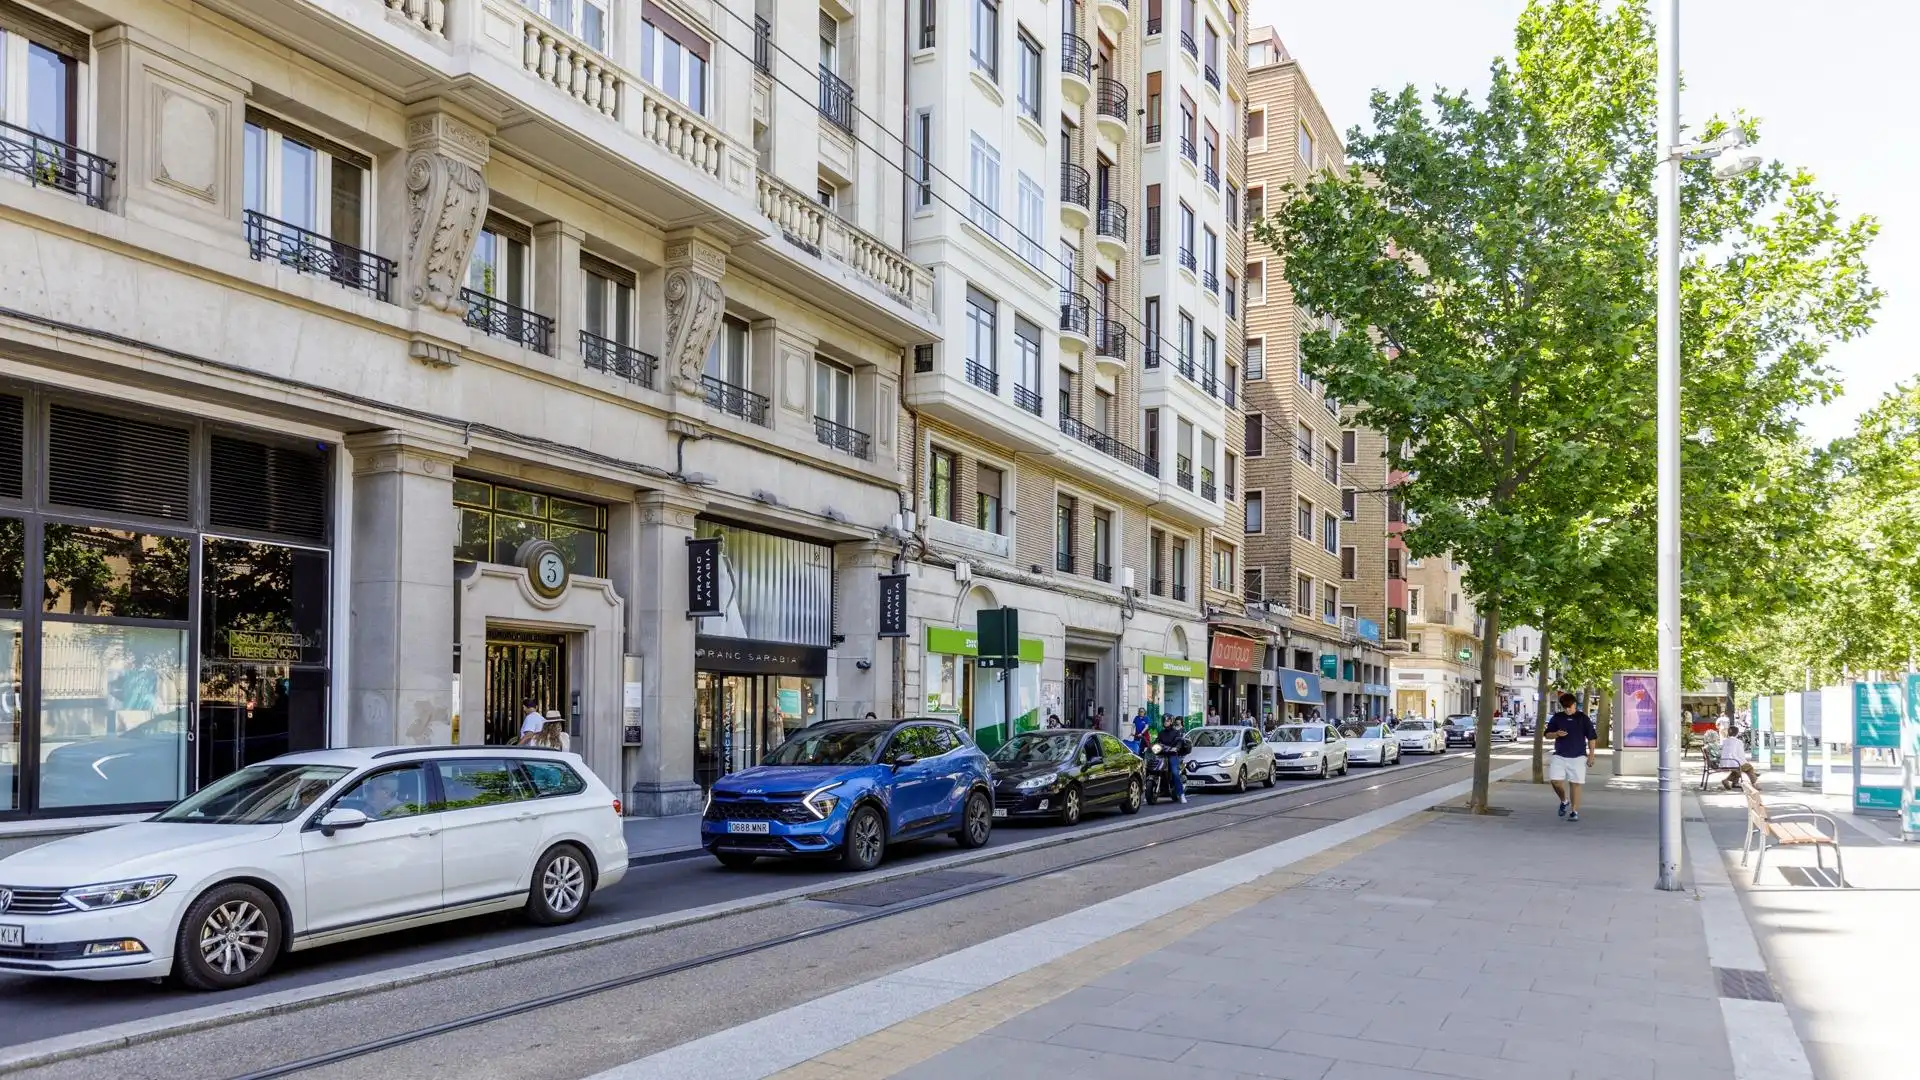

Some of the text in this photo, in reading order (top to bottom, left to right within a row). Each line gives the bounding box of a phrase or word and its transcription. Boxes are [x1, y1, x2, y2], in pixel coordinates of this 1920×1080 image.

[547, 560, 557, 583] 3
[239, 634, 292, 646] SALIDA DE
[232, 646, 299, 659] EMERGENCIA
[697, 649, 797, 664] RANC SARABIA
[731, 821, 767, 832] 0688 MNR
